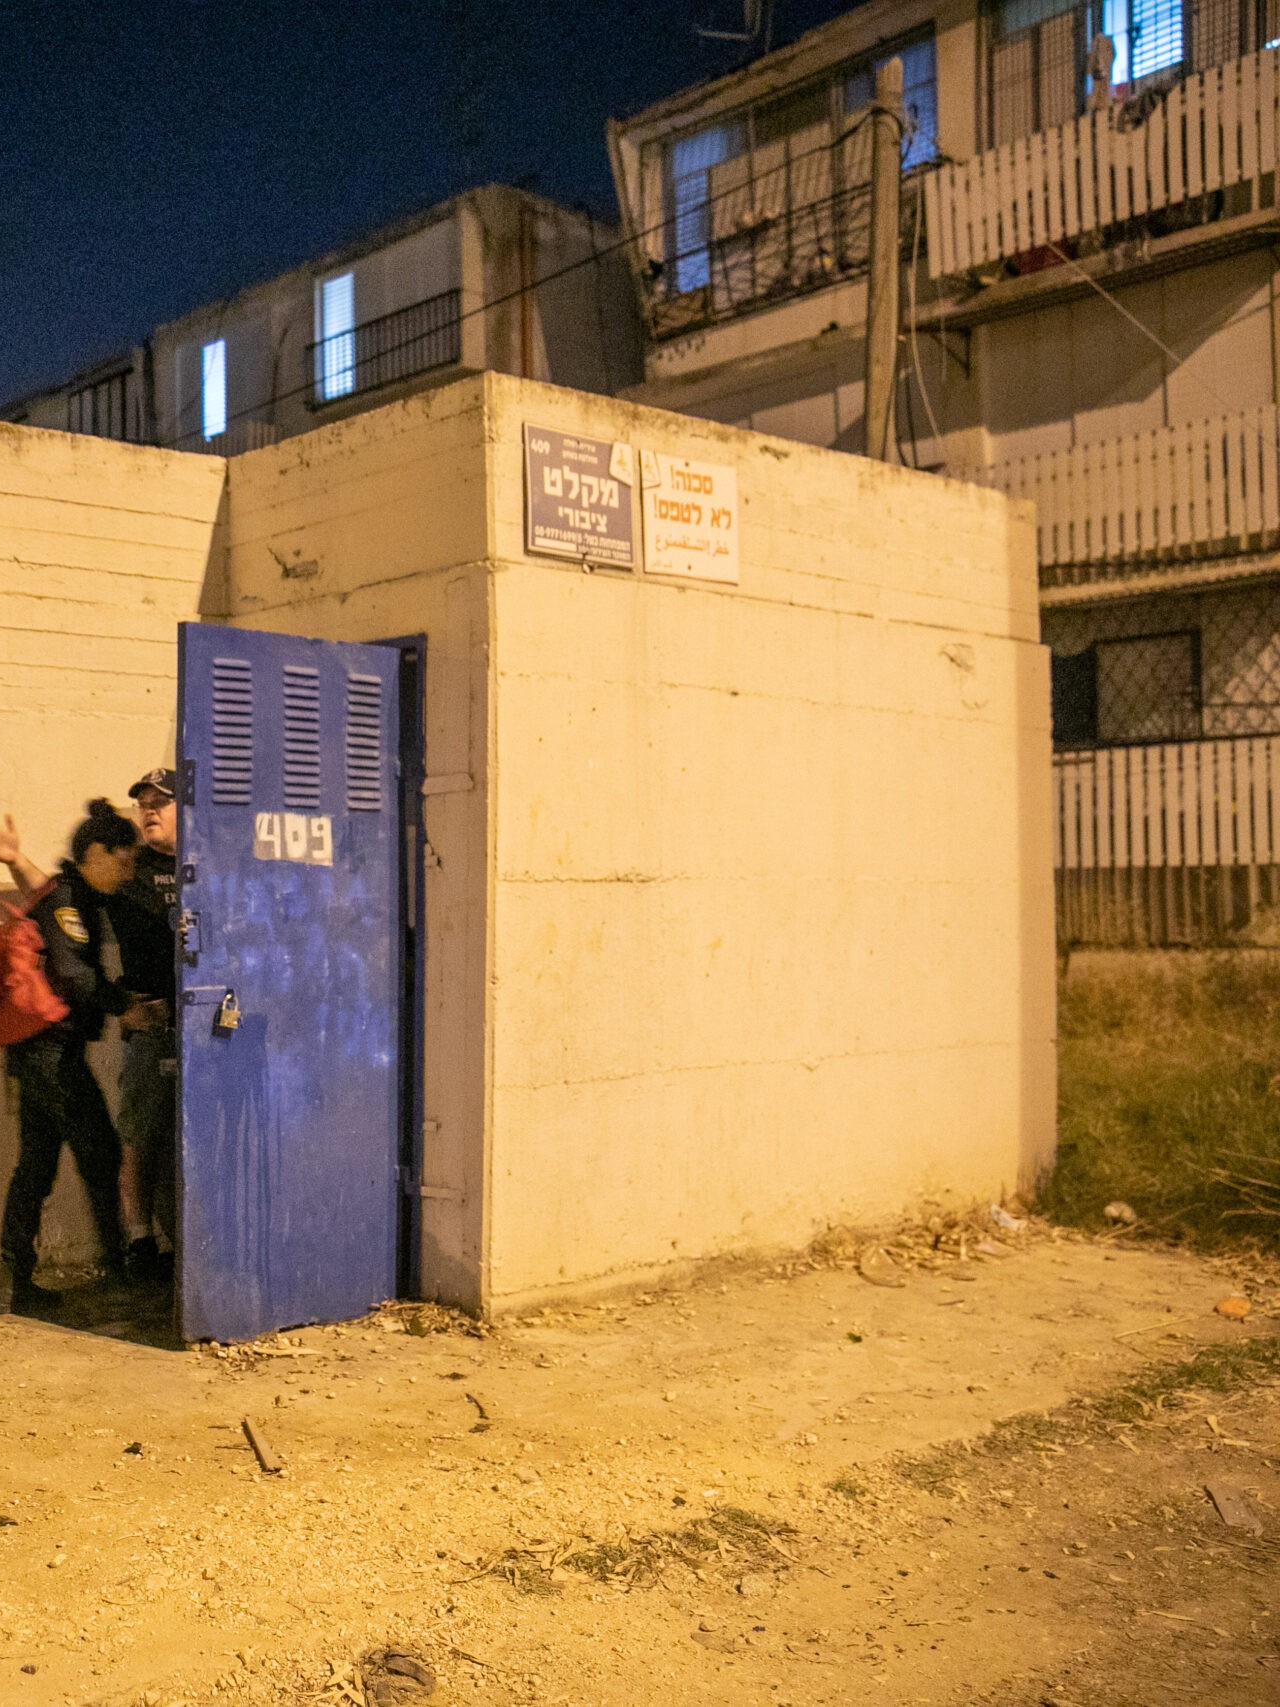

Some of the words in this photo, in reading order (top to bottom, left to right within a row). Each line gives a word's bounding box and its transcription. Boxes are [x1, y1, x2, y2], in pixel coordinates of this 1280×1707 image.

[530, 438, 550, 455] 409
[543, 465, 619, 508] מקלט
[670, 464, 713, 495] סכנה!
[558, 506, 608, 533] ציבורי
[653, 493, 702, 525] לטפס!
[710, 507, 732, 530] לא
[256, 812, 333, 866] 409
